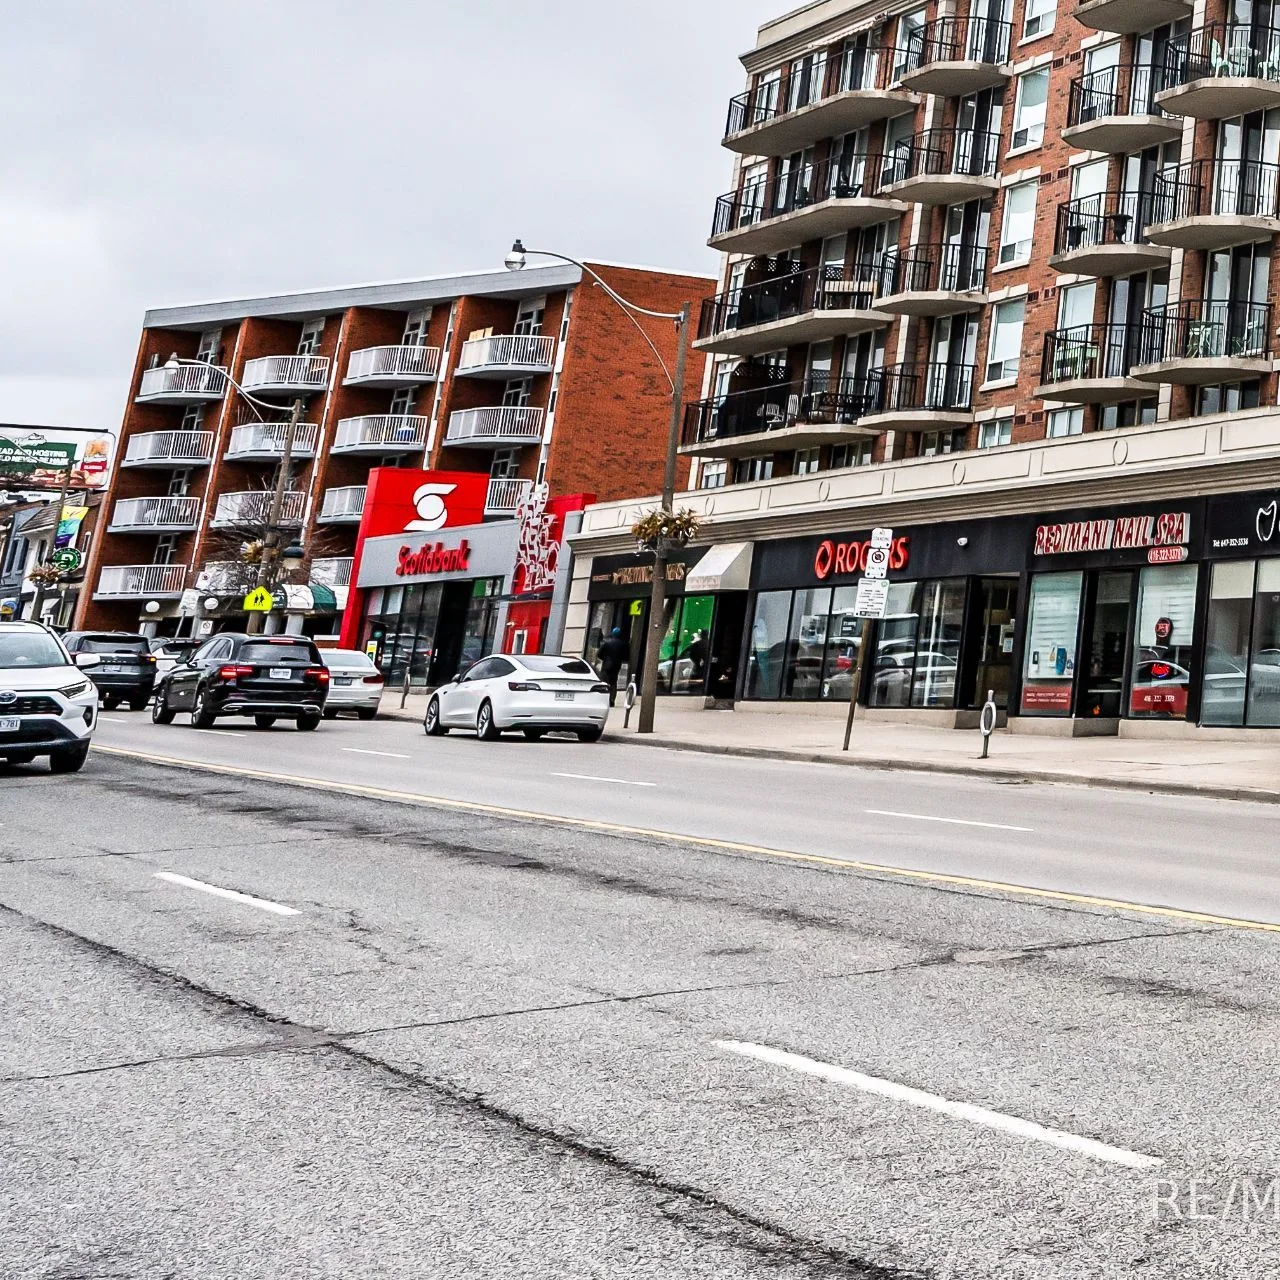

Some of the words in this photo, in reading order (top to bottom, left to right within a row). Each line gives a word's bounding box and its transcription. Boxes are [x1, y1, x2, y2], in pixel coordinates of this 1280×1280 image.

[33, 450, 67, 458] HOSTING
[1034, 519, 1114, 555] PEDIMANI
[1113, 516, 1155, 549] NAIL
[1154, 512, 1190, 546] SPA
[396, 539, 472, 576] Scotiabank
